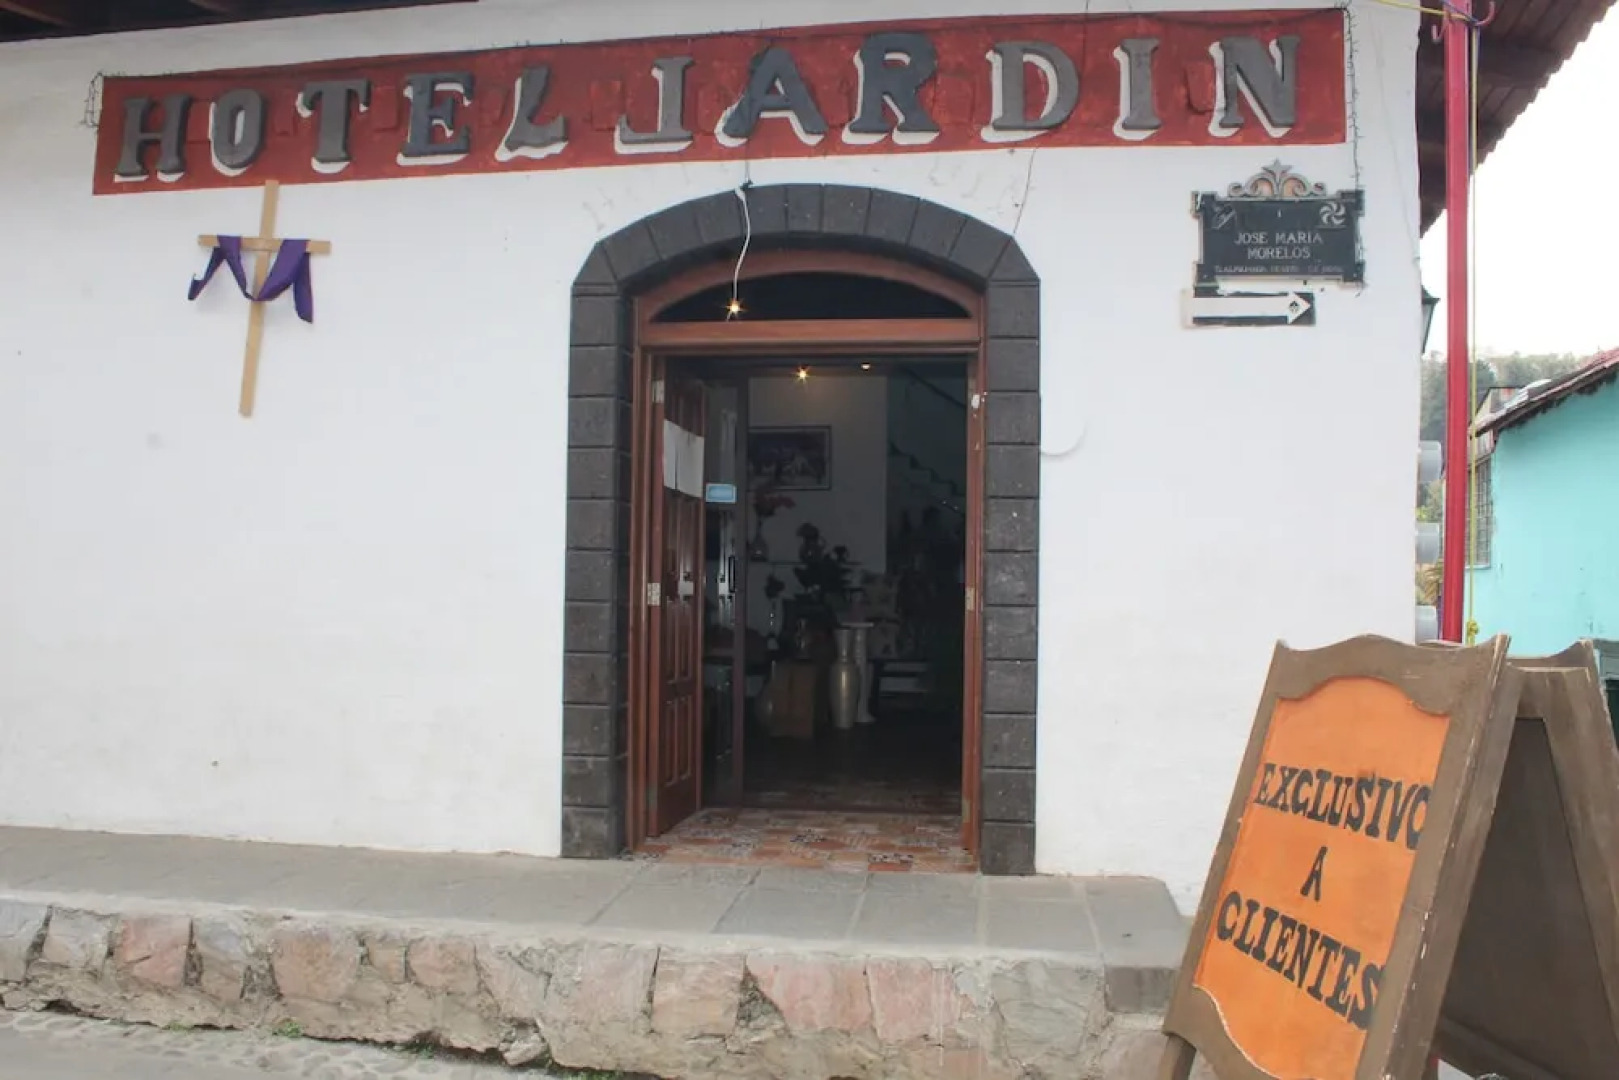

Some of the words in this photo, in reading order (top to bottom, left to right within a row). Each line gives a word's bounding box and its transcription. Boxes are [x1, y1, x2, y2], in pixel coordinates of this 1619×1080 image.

[113, 65, 569, 183] HOTEL
[614, 32, 1298, 154] JARDIN
[1234, 231, 1268, 245] JOSE
[1275, 231, 1324, 245] MARIA
[1247, 246, 1311, 260] MORELOS
[1253, 763, 1432, 850] EXCLUSIVO
[1300, 846, 1329, 902] A
[1216, 891, 1385, 1030] CLIENTES
